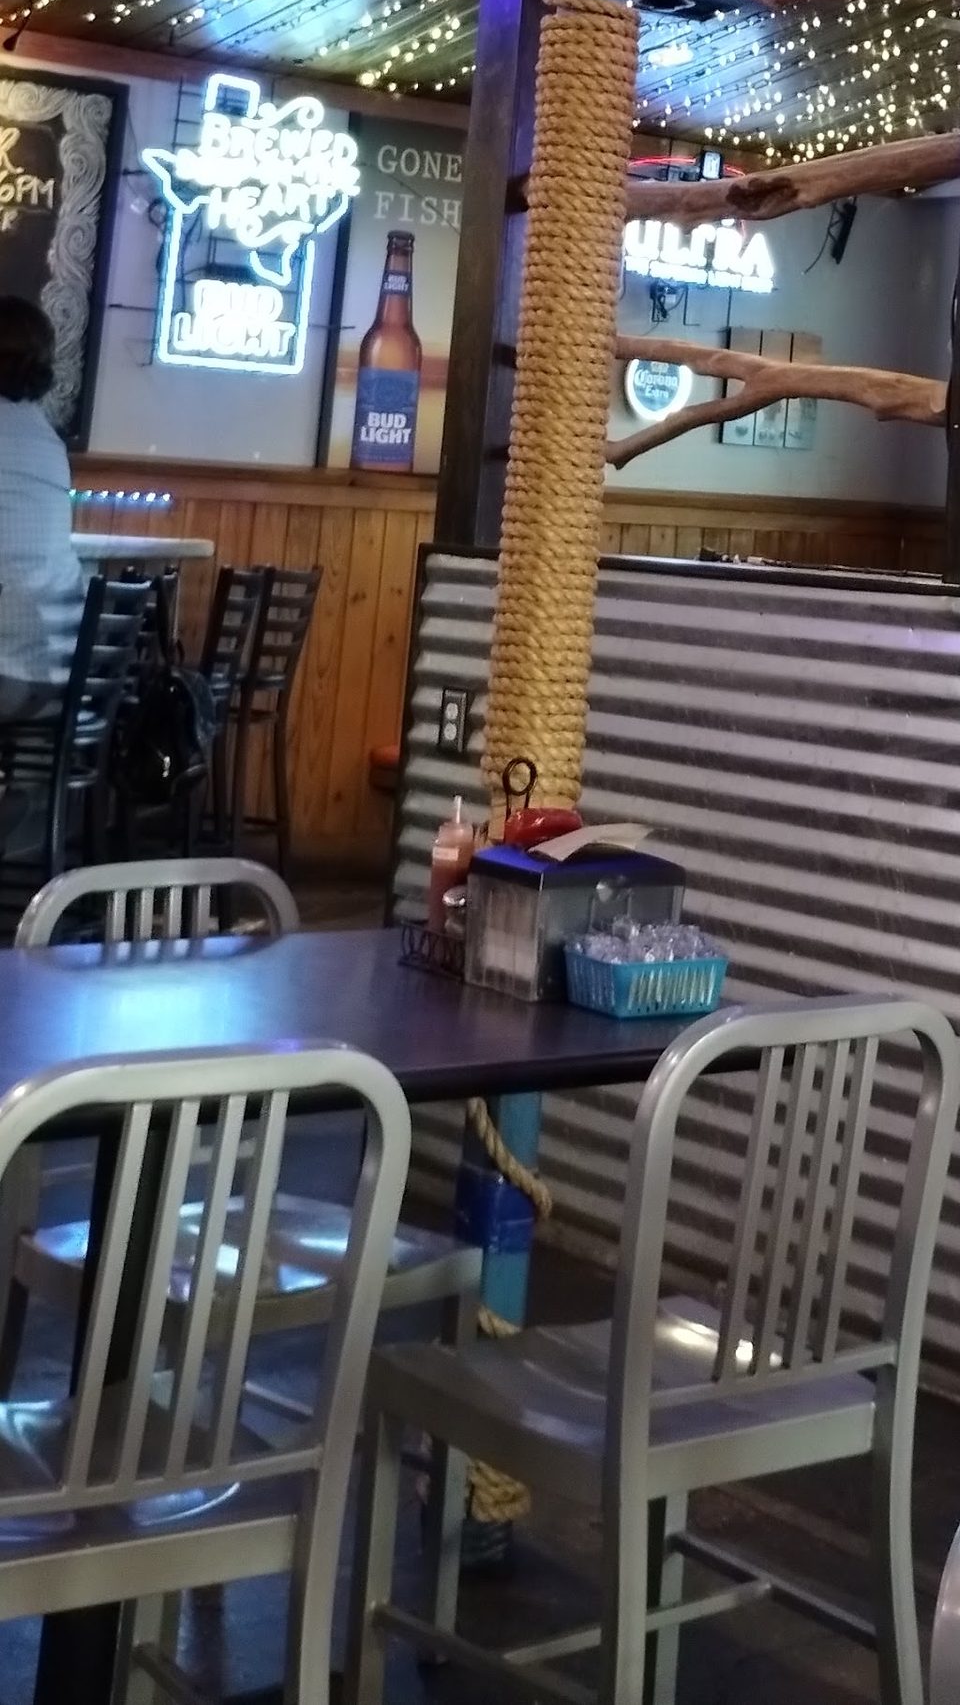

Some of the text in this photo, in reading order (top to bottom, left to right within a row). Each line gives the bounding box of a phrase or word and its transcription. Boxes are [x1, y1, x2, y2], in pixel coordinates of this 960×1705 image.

[377, 144, 462, 182] GONE
[374, 191, 462, 229] FISH
[634, 369, 678, 388] Corona
[367, 411, 407, 429] BUD
[360, 426, 412, 445] LIGHT
